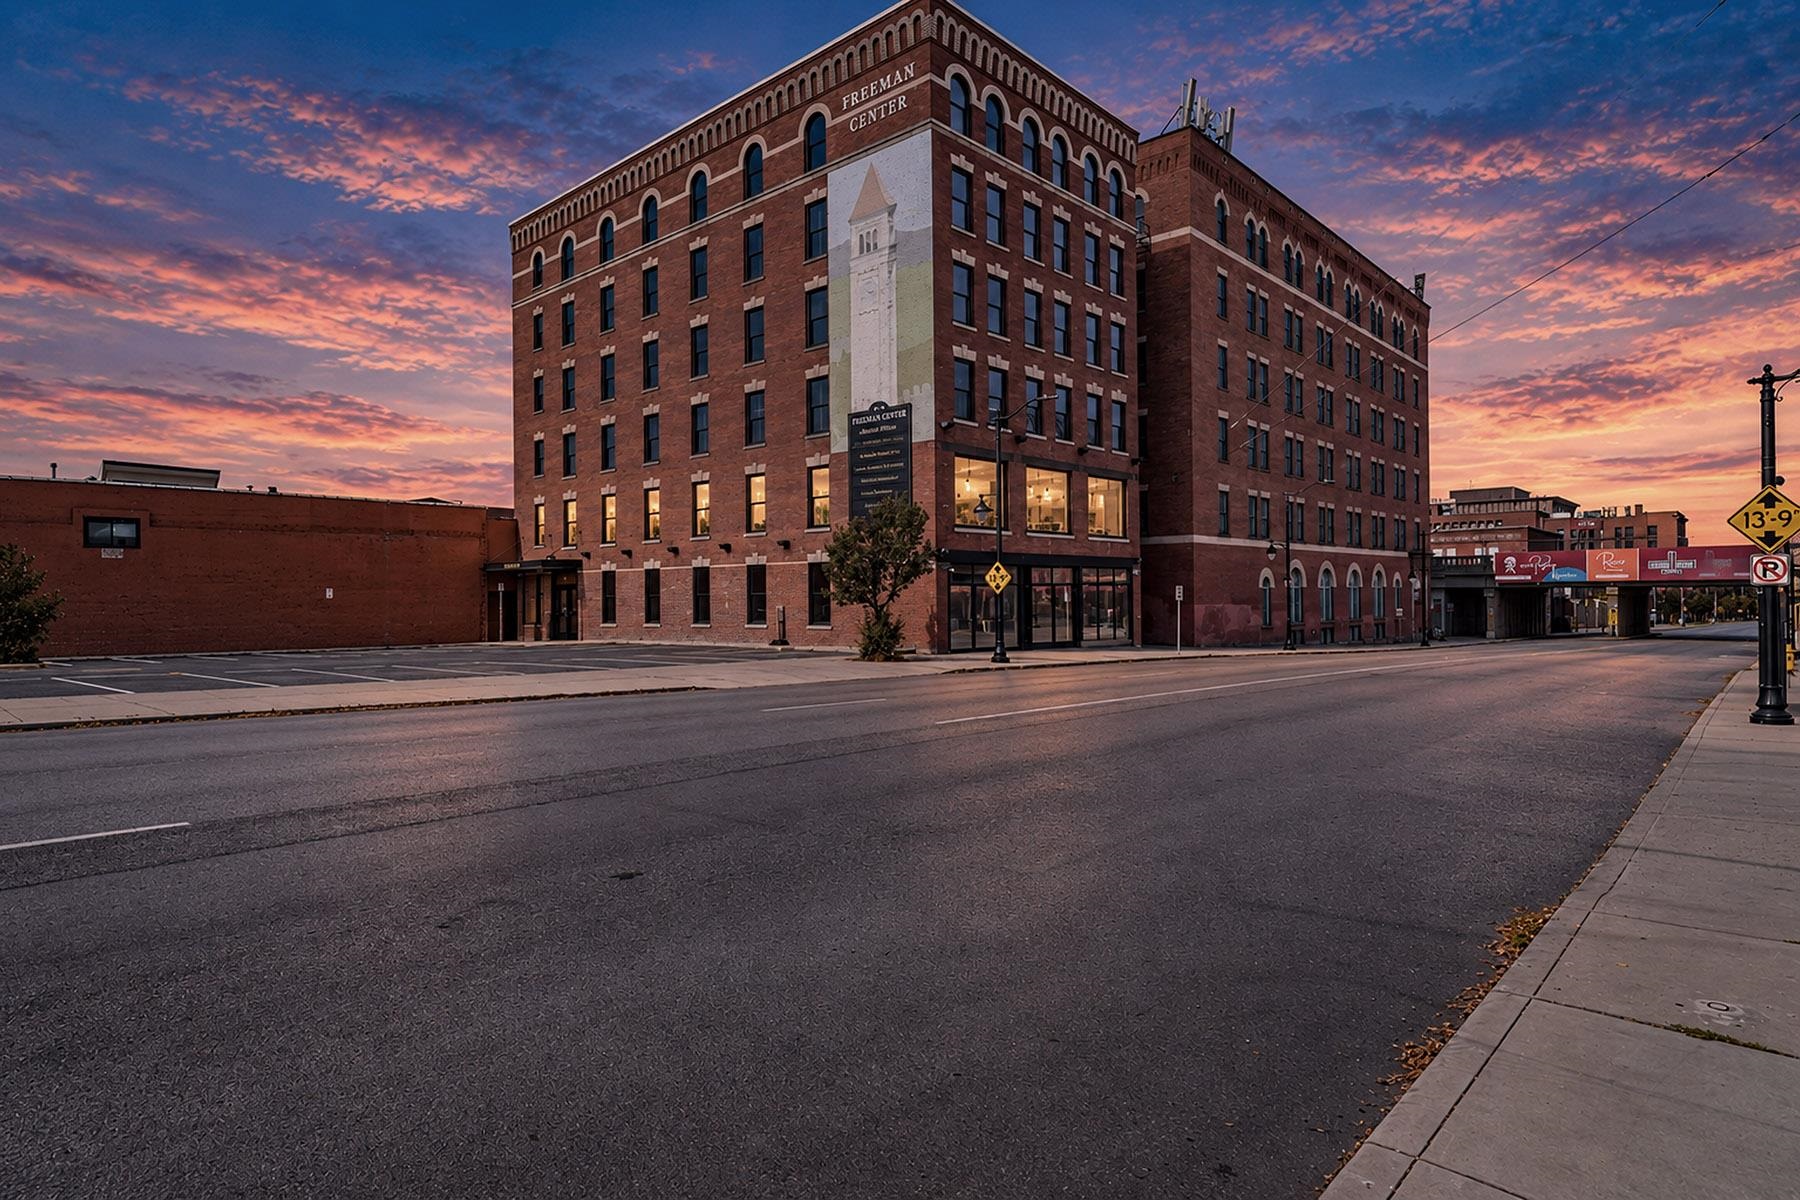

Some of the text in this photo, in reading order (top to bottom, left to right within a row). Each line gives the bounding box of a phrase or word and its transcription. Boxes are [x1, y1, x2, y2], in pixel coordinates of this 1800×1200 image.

[842, 62, 915, 110] FREEMAN
[849, 95, 907, 132] CENTER
[881, 409, 907, 420] CENTER
